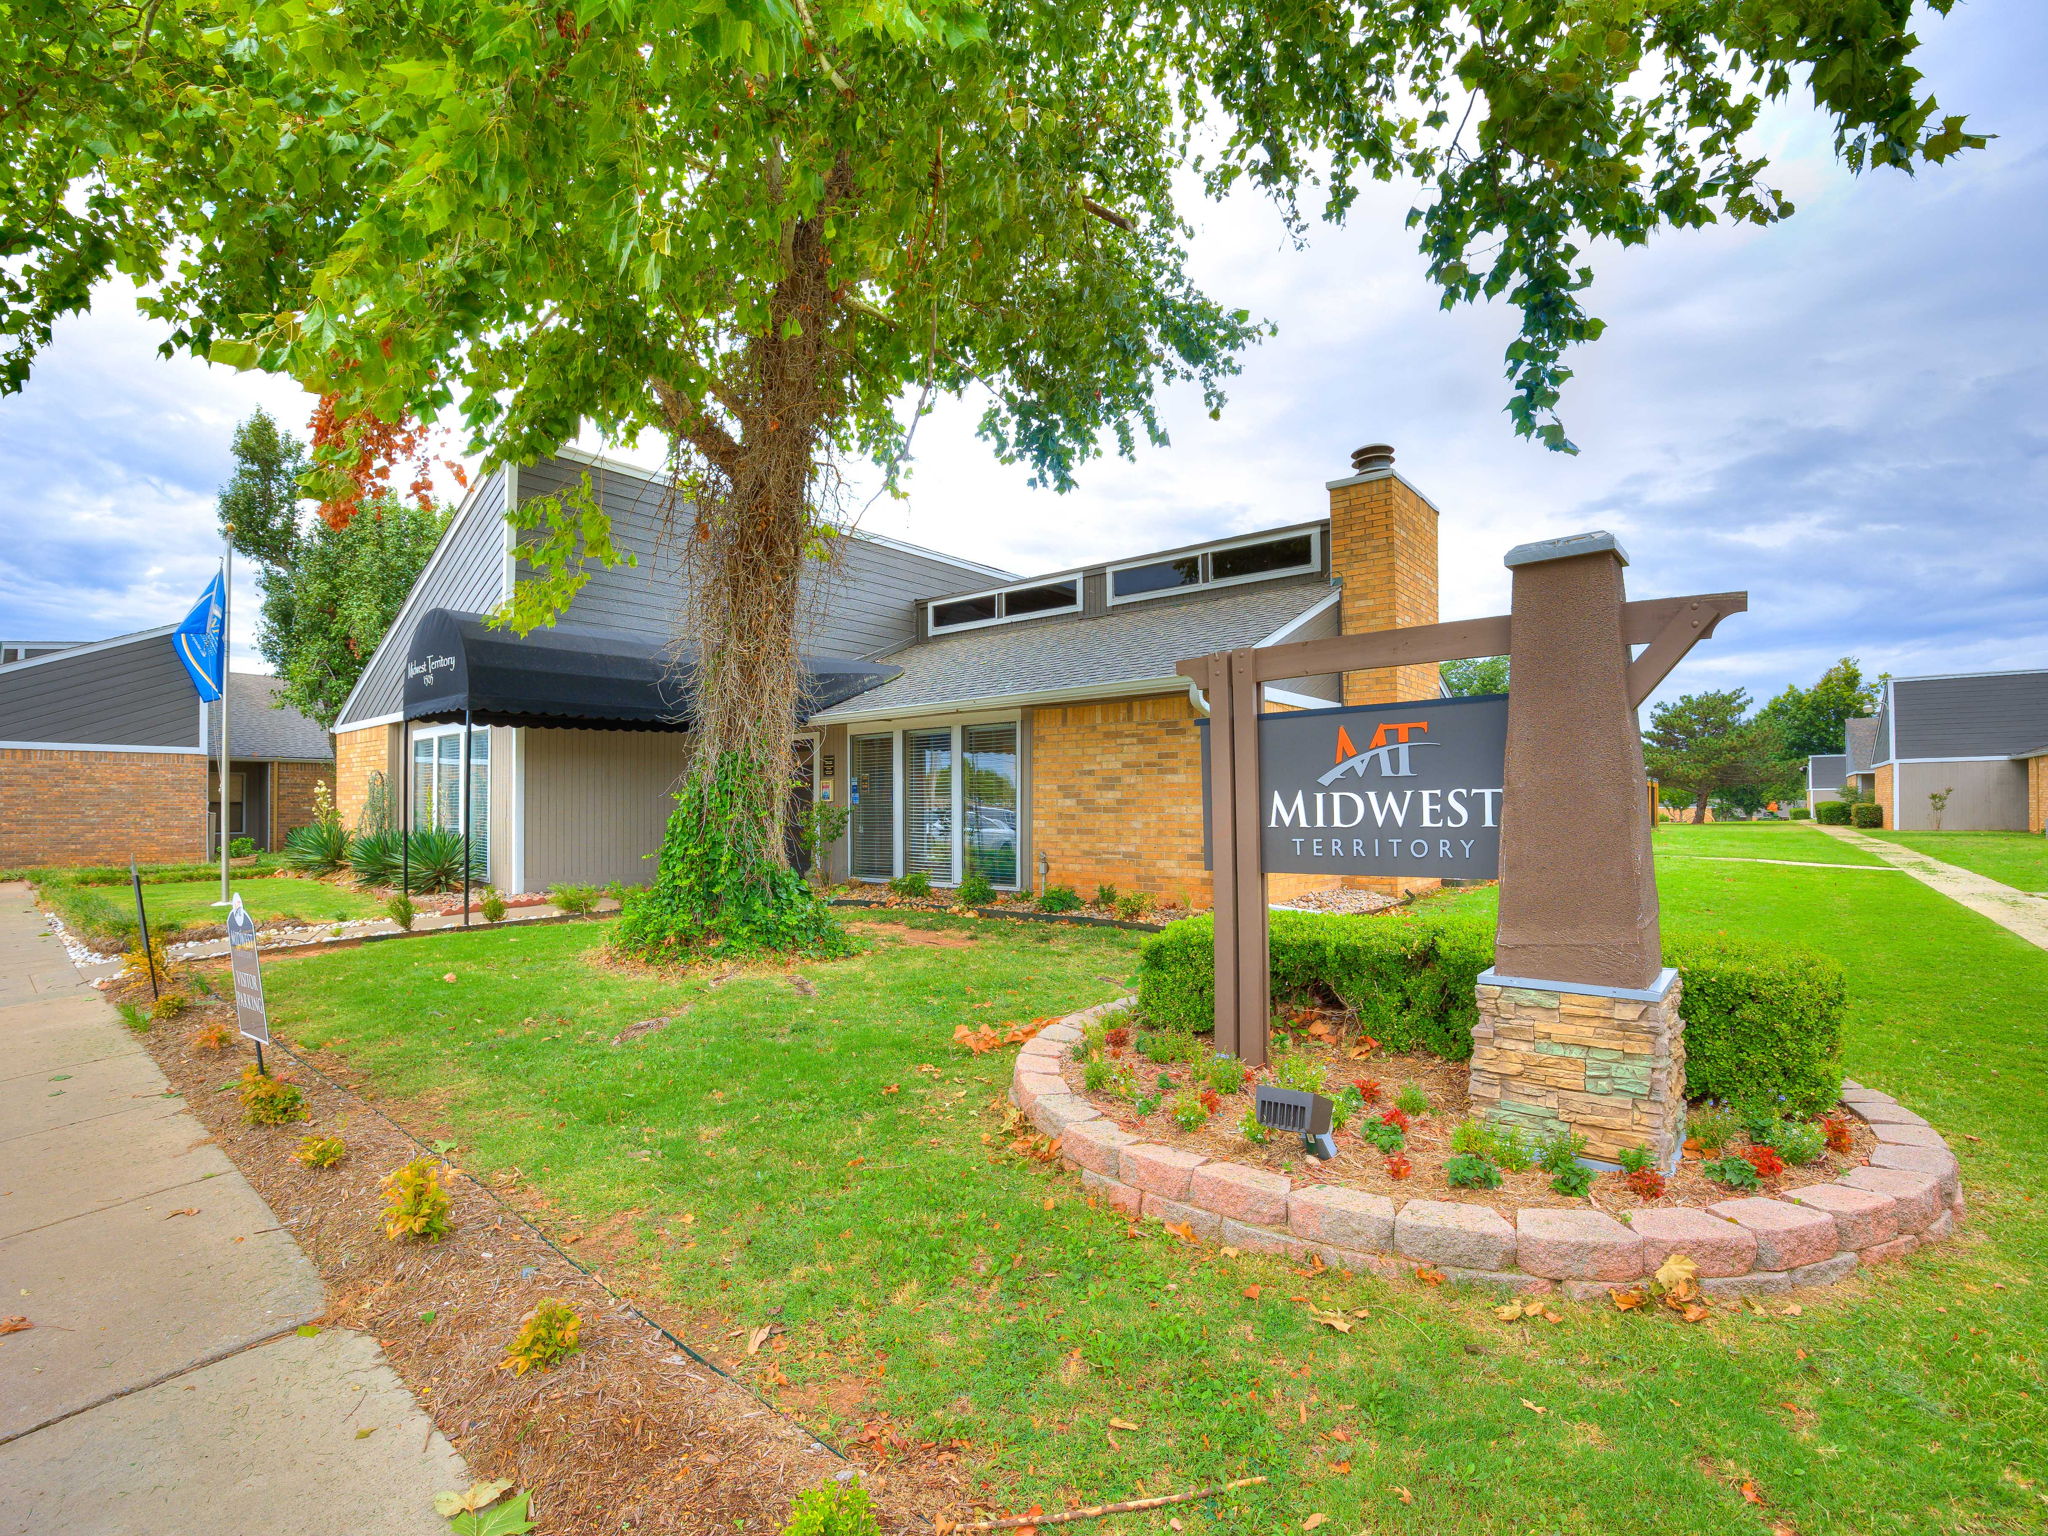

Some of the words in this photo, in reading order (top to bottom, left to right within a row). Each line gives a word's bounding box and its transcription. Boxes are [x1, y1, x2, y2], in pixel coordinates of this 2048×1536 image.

[426, 654, 456, 673] Territory
[1267, 788, 1503, 828] MIDWEST
[1291, 838, 1475, 859] TERRITORY
[236, 970, 258, 991] VISITOR
[236, 990, 264, 1013] PARKING
